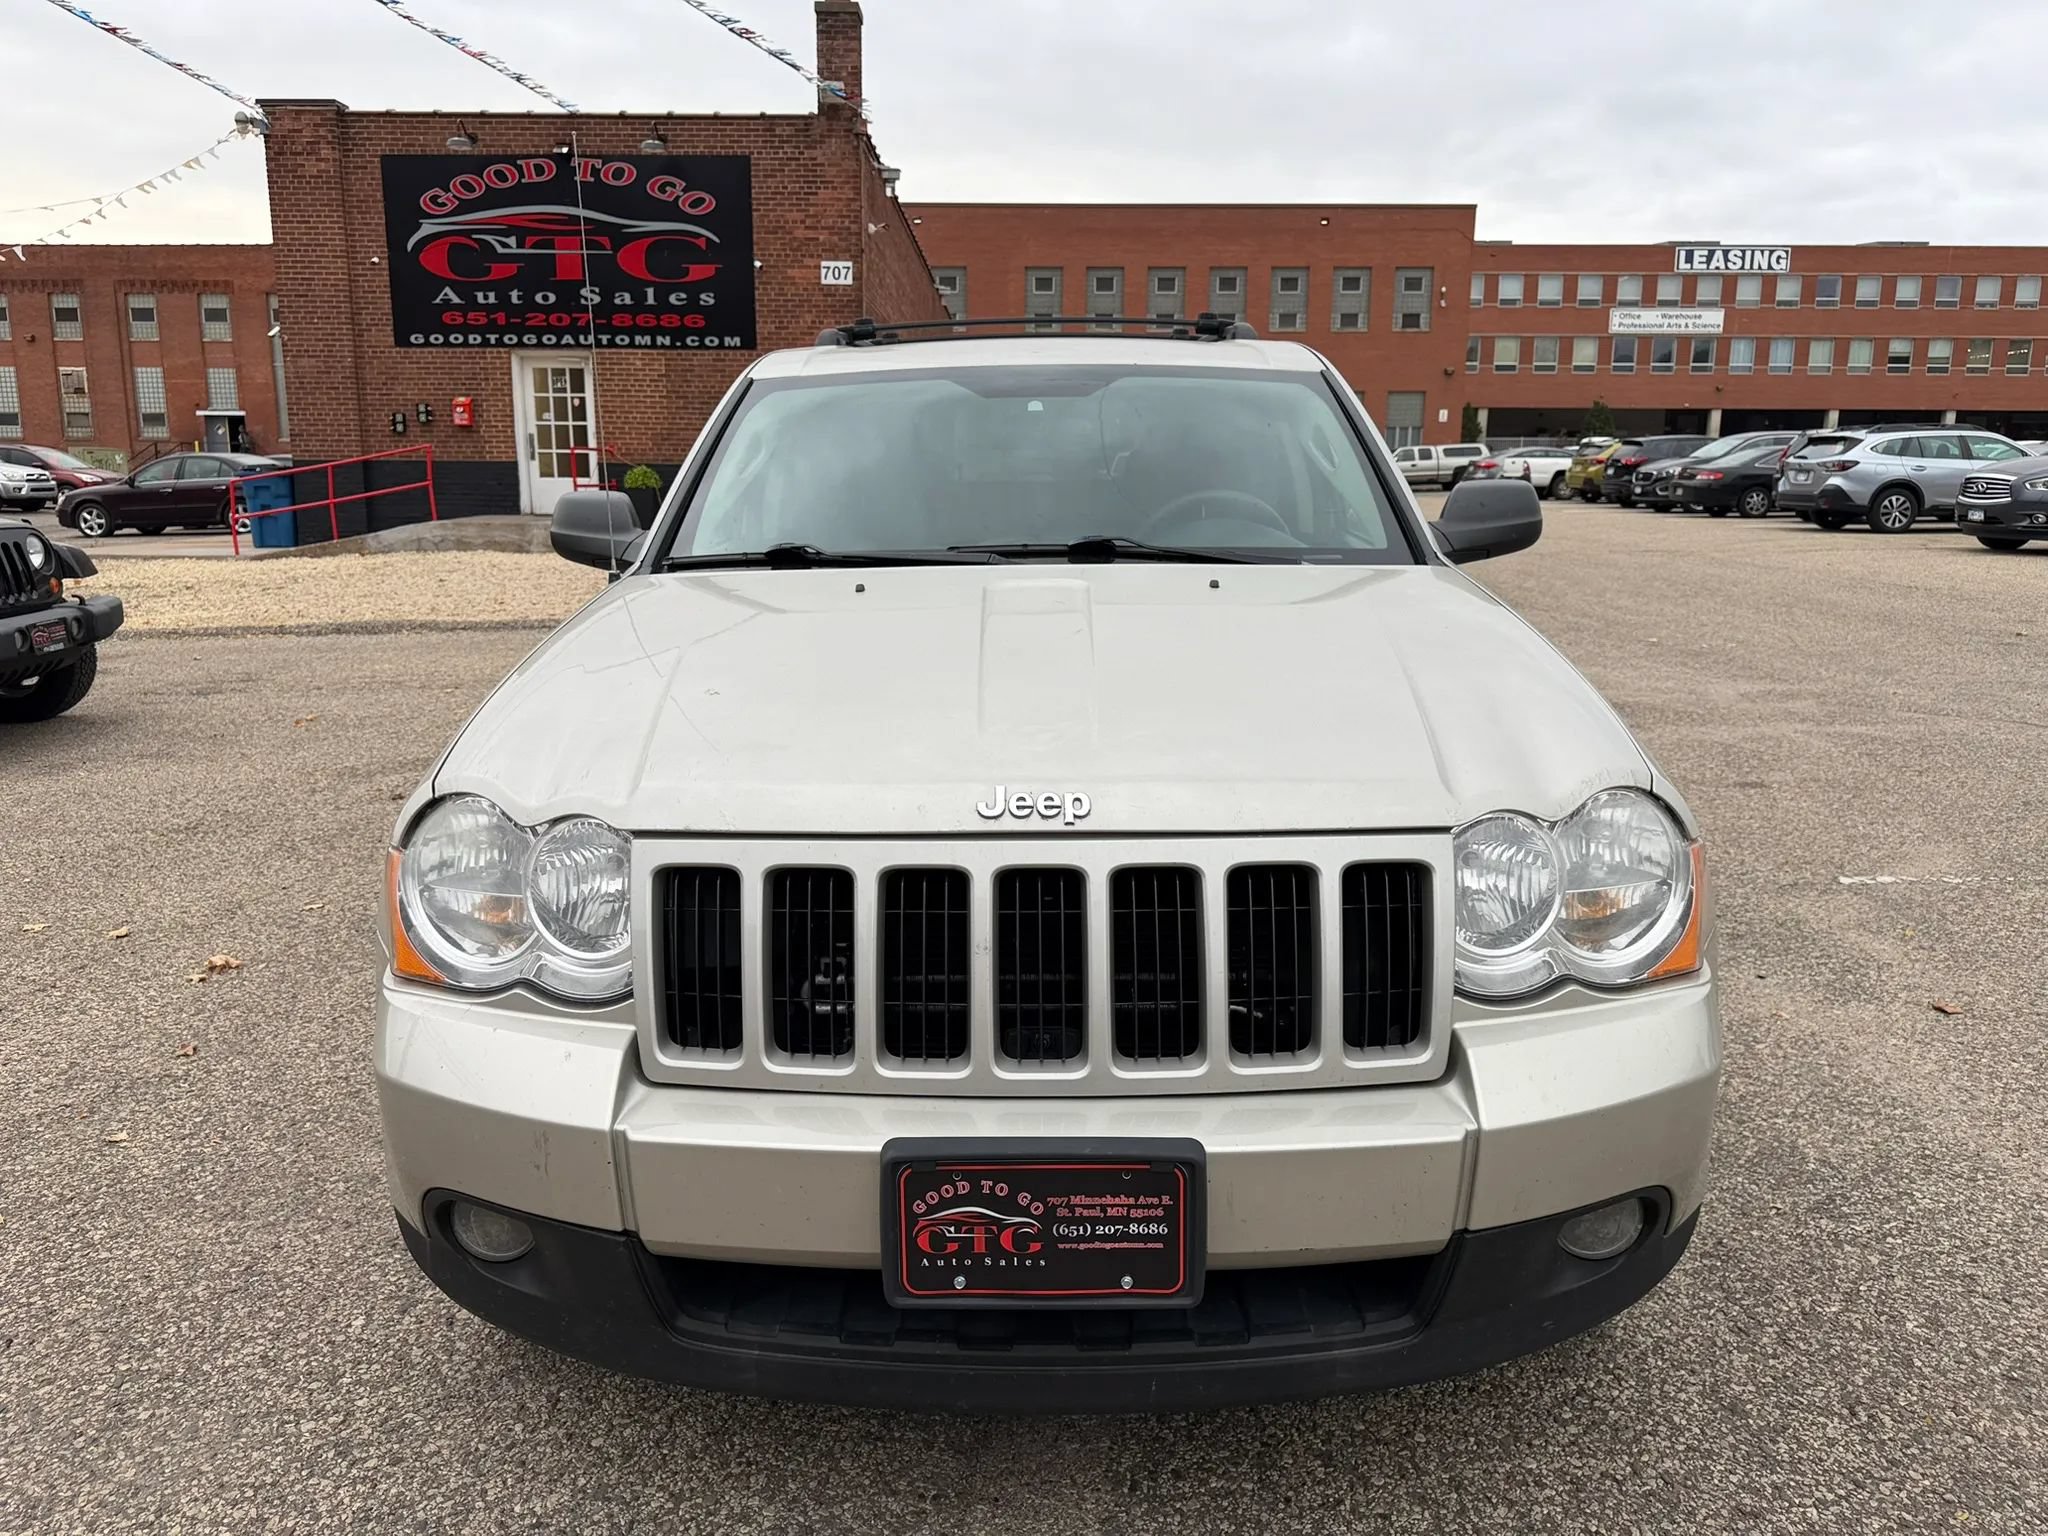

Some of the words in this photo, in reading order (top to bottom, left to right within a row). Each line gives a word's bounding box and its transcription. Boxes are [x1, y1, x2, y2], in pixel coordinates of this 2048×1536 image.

[419, 158, 557, 215] GOOD
[570, 157, 637, 186] TO
[646, 175, 717, 215] GO
[418, 235, 723, 283] GTG
[1678, 249, 1788, 271] LEASING
[822, 265, 851, 281] 707
[432, 285, 557, 305] Auto
[579, 286, 716, 306] Sales
[441, 311, 706, 328] 651-207-8686
[1618, 312, 1642, 320] Office
[1660, 312, 1703, 320] Warehouse
[1618, 321, 1665, 329] Professional
[1666, 321, 1681, 329] Arts
[1684, 321, 1690, 329] &
[1691, 321, 1721, 329] Science
[409, 332, 742, 348] GOODTOGOAUTOMN.COM
[976, 784, 1092, 826] Jeep
[912, 1181, 970, 1214] GOOD
[981, 1180, 1009, 1196] TO
[1017, 1192, 1044, 1215] GO
[1047, 1196, 1069, 1207] 707
[1070, 1194, 1136, 1205] Minnehaha
[1136, 1195, 1160, 1205] Ave
[1161, 1195, 1174, 1205] E.
[1056, 1207, 1072, 1217] St.
[1074, 1207, 1104, 1218] Paul,
[1106, 1207, 1128, 1217] MN
[1129, 1207, 1165, 1218] 55106
[1052, 1222, 1092, 1237] (651)
[1095, 1222, 1169, 1237] 207-8686
[916, 1225, 1044, 1254] GTG
[921, 1257, 972, 1267] Auto
[984, 1257, 1046, 1267] Sales
